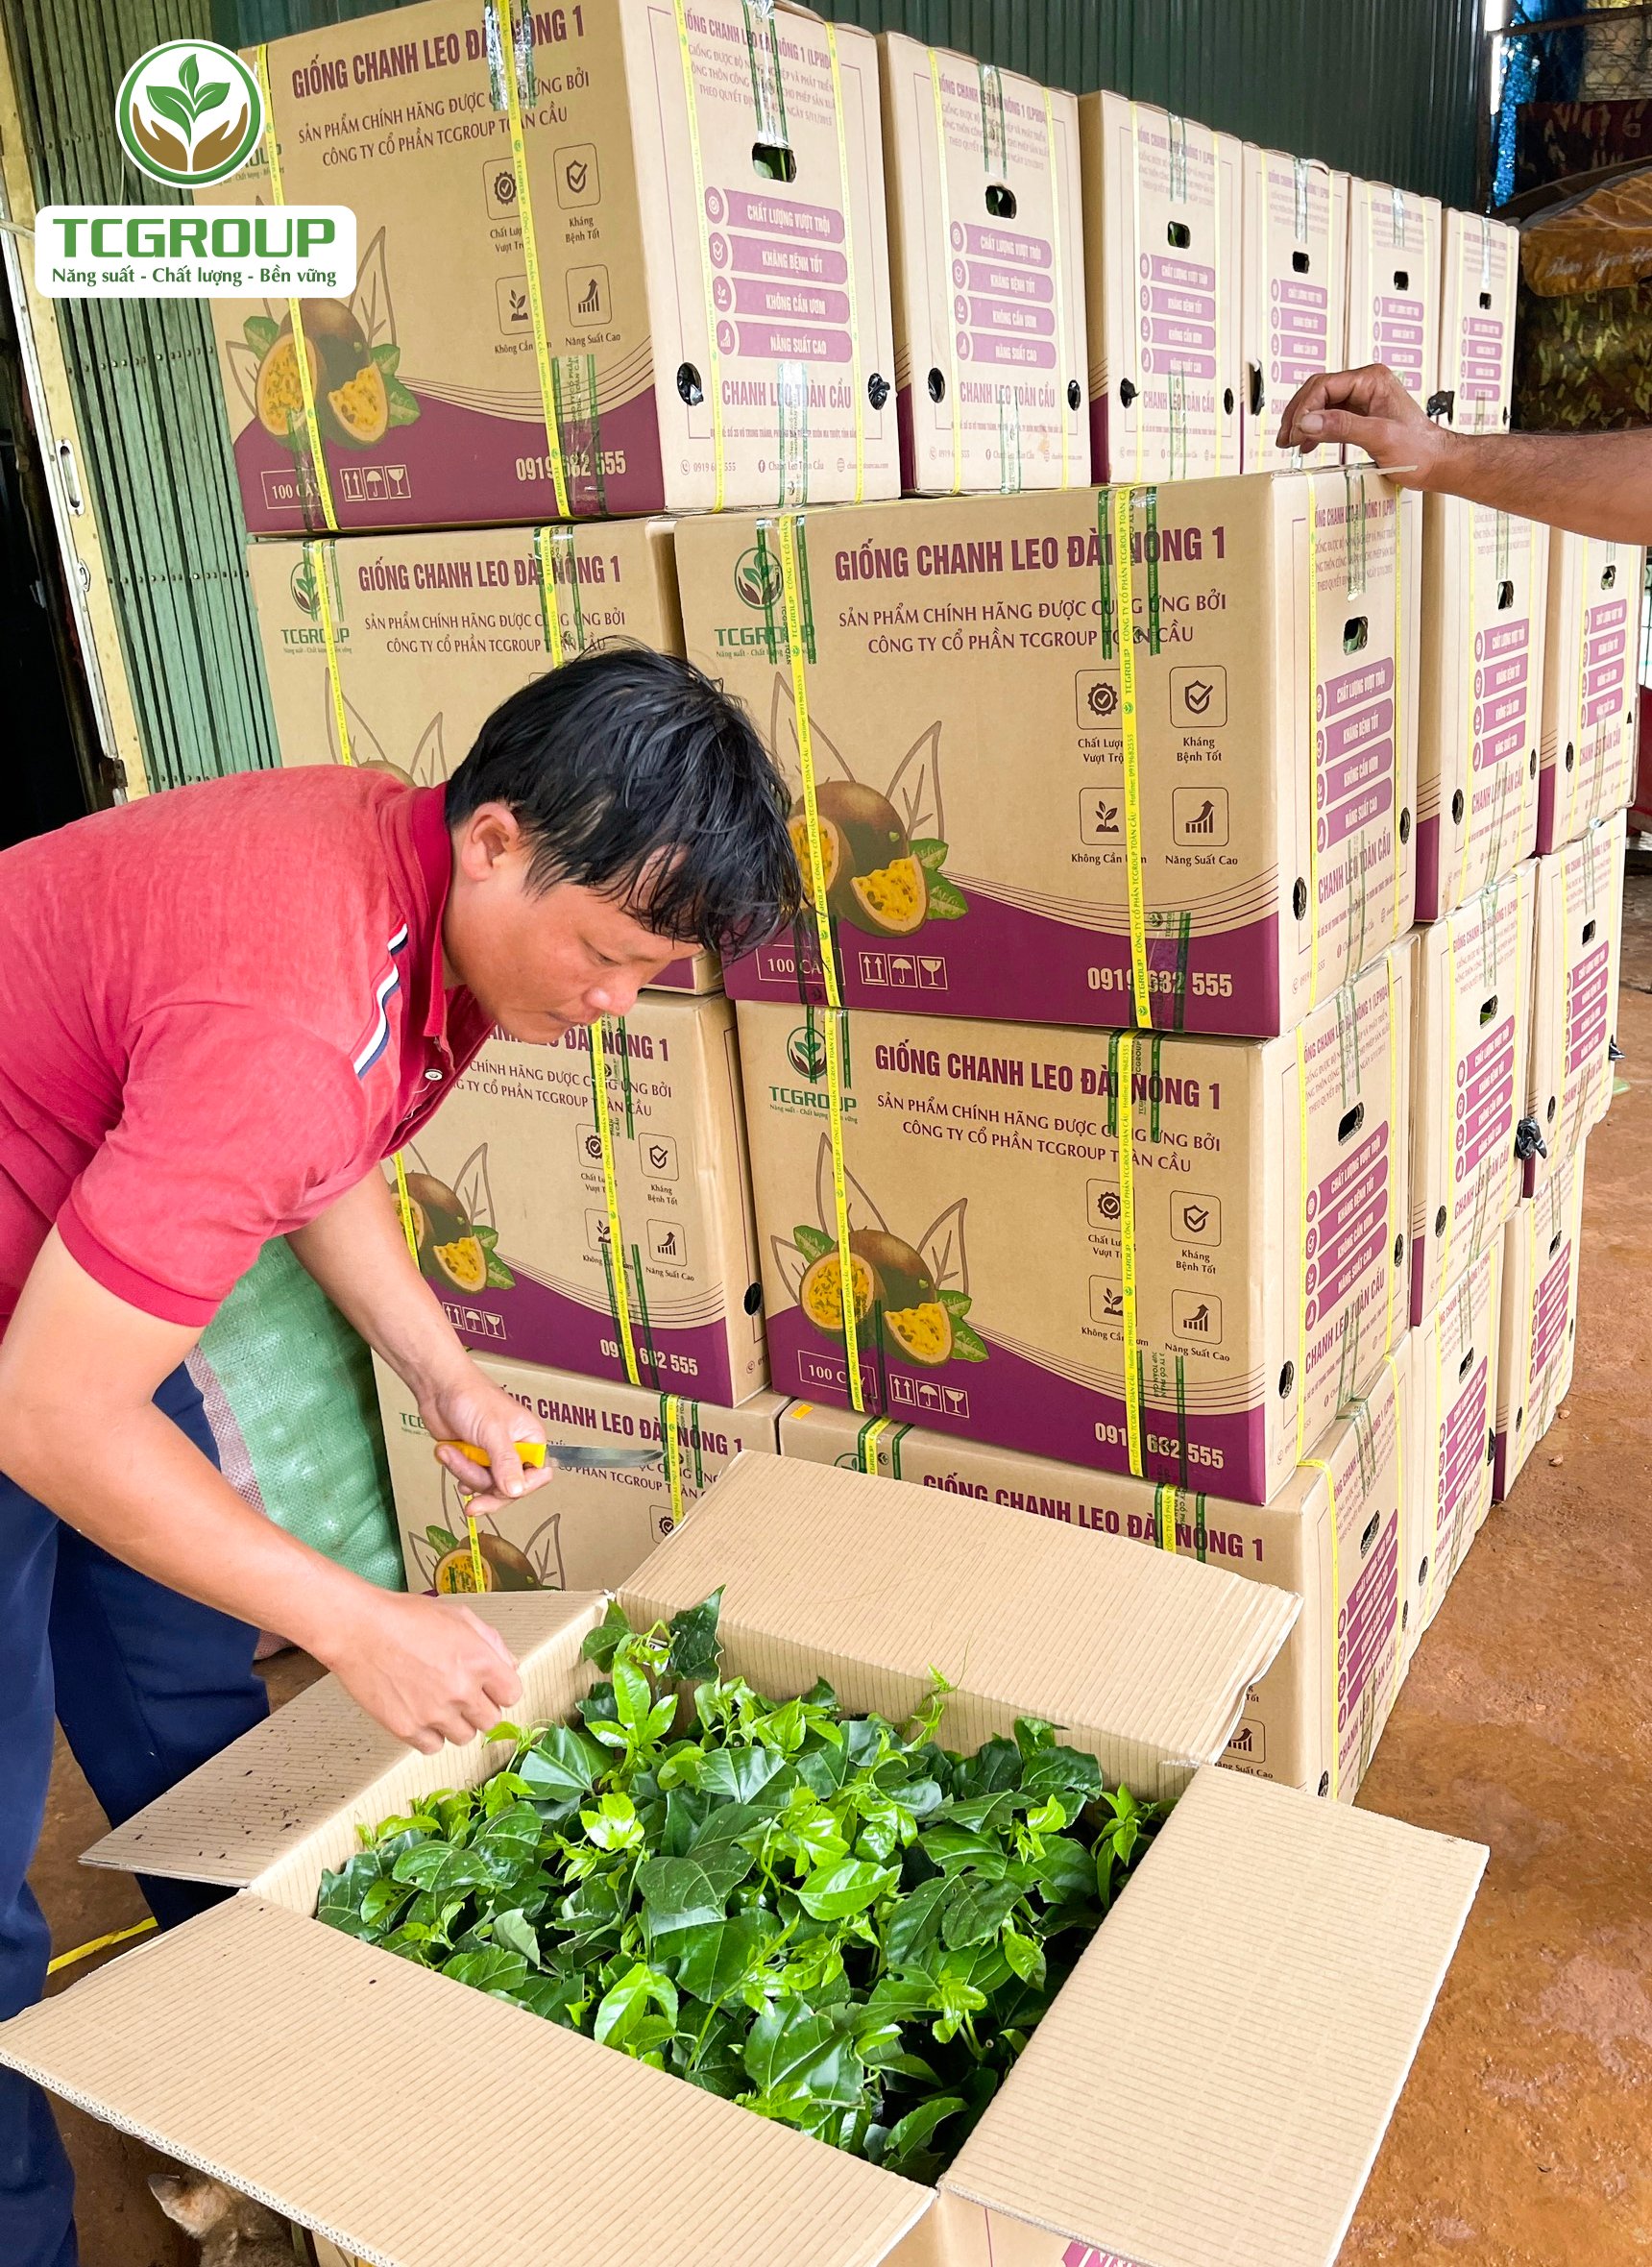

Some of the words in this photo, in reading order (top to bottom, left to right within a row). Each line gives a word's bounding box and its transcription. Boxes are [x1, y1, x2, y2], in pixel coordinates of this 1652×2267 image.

[292, 54, 349, 99] GIỐNG
[352, 41, 419, 85] CHANH
[423, 33, 460, 69] LEO
[572, 5, 584, 37] 1
[299, 123, 321, 143] SẢN
[325, 113, 359, 139] PHẨM
[362, 104, 403, 131] CHÍNH
[406, 100, 445, 122] HÃNG
[449, 91, 485, 114] ĐƯỢC
[567, 67, 589, 90] BỞI
[323, 142, 356, 166] CÔNG
[360, 143, 375, 158] TY
[378, 132, 395, 156] CỔ
[399, 127, 433, 153] PHẦN
[437, 120, 496, 145] TCGROUP
[539, 101, 568, 126] CẦU
[762, 249, 788, 268] KHÁNG
[810, 256, 822, 273] TỐT
[765, 292, 792, 310] KHÔNG
[813, 340, 827, 354] CAO
[722, 380, 766, 406] CHANH
[830, 378, 851, 408] CẦU
[960, 381, 992, 403] CHANH
[1039, 381, 1055, 407] CẦU
[272, 484, 293, 500] 100
[835, 537, 910, 581] GIỐNG
[916, 540, 1003, 576] CHANH
[1011, 536, 1058, 571] LEO
[1212, 525, 1225, 559] 1
[358, 556, 410, 592] GIỐNG
[414, 560, 474, 590] CHANH
[476, 559, 508, 588] LEO
[610, 555, 620, 582] 1
[365, 612, 387, 630] SẢN
[388, 610, 420, 629] PHẨM
[422, 612, 458, 629] CHÍNH
[462, 611, 497, 627] HÃNG
[499, 612, 532, 629] ĐƯỢC
[605, 607, 625, 625] BỞI
[838, 606, 869, 626] SẢN
[873, 602, 919, 625] PHẨM
[923, 602, 977, 623] CHÍNH
[985, 600, 1032, 621] HÃNG
[1038, 598, 1086, 622] ĐƯỢC
[1196, 588, 1227, 612] BỞI
[387, 638, 417, 653] CÔNG
[420, 641, 434, 653] TY
[436, 634, 452, 653] CỔ
[455, 633, 487, 652] PHẦN
[490, 640, 541, 653] TCGROUP
[868, 632, 913, 654] CÔNG
[917, 636, 936, 651] TY
[940, 627, 963, 650] CỔ
[968, 626, 1014, 649] PHẦN
[1020, 631, 1098, 647] TCGROUP
[1158, 619, 1193, 642] CẦU
[1078, 737, 1101, 748] Chất
[1183, 737, 1215, 748] Kháng
[1083, 753, 1105, 765] Vượt
[1177, 752, 1203, 764] Bệnh
[1206, 750, 1222, 761] Tốt
[1071, 854, 1101, 865] Không
[1104, 851, 1122, 863] Cần
[1165, 855, 1192, 866] Năng
[1195, 853, 1216, 865] Suất
[1219, 855, 1238, 865] Cao
[1319, 865, 1344, 904] CHANH
[768, 959, 794, 973] 100
[1192, 972, 1232, 997] 555
[659, 1038, 668, 1061] 1
[509, 1063, 544, 1081] HÃNG
[547, 1070, 579, 1087] ĐƯỢC
[652, 1082, 672, 1098] BỞI
[875, 1039, 940, 1077] GIỐNG
[948, 1053, 1024, 1086] CHANH
[1031, 1062, 1073, 1092] LEO
[1208, 1083, 1220, 1110] 1
[467, 1080, 480, 1092] TY
[483, 1079, 498, 1095] CỔ
[501, 1082, 533, 1100] PHẦN
[535, 1090, 588, 1108] TCGROUP
[877, 1091, 904, 1111] SẢN
[908, 1096, 949, 1116] PHẨM
[952, 1104, 999, 1123] CHÍNH
[1004, 1109, 1049, 1130] HÃNG
[1054, 1116, 1097, 1137] ĐƯỢC
[1194, 1133, 1221, 1152] BỞI
[903, 1119, 943, 1138] CÔNG
[946, 1127, 963, 1141] TY
[967, 1124, 987, 1145] CỔ
[992, 1130, 1032, 1151] PHẦN
[1037, 1140, 1106, 1160] TCGROUP
[1157, 1151, 1191, 1172] CẦU
[1088, 1234, 1108, 1245] Chất
[1093, 1247, 1112, 1258] Vượt
[1181, 1249, 1210, 1263] Kháng
[1176, 1261, 1200, 1272] Bệnh
[1201, 1263, 1216, 1275] Tốt
[1306, 1327, 1334, 1375] CHANH
[1371, 1267, 1385, 1303] CẦU
[1081, 1327, 1108, 1340] Không
[1165, 1343, 1189, 1355] Năng
[1191, 1347, 1209, 1358] Suất
[1213, 1352, 1229, 1361] Cao
[669, 1354, 698, 1376] 555
[809, 1365, 833, 1380] 100
[538, 1399, 597, 1429] CHANH
[601, 1409, 634, 1436] LEO
[1188, 1443, 1225, 1469] 555
[610, 1472, 662, 1491] TCGROUP
[996, 1488, 1072, 1524] CHANH
[1079, 1501, 1120, 1534] LEO
[1252, 1539, 1264, 1562] 1
[1235, 1765, 1253, 1775] Suất
[1256, 1769, 1273, 1779] Cao
